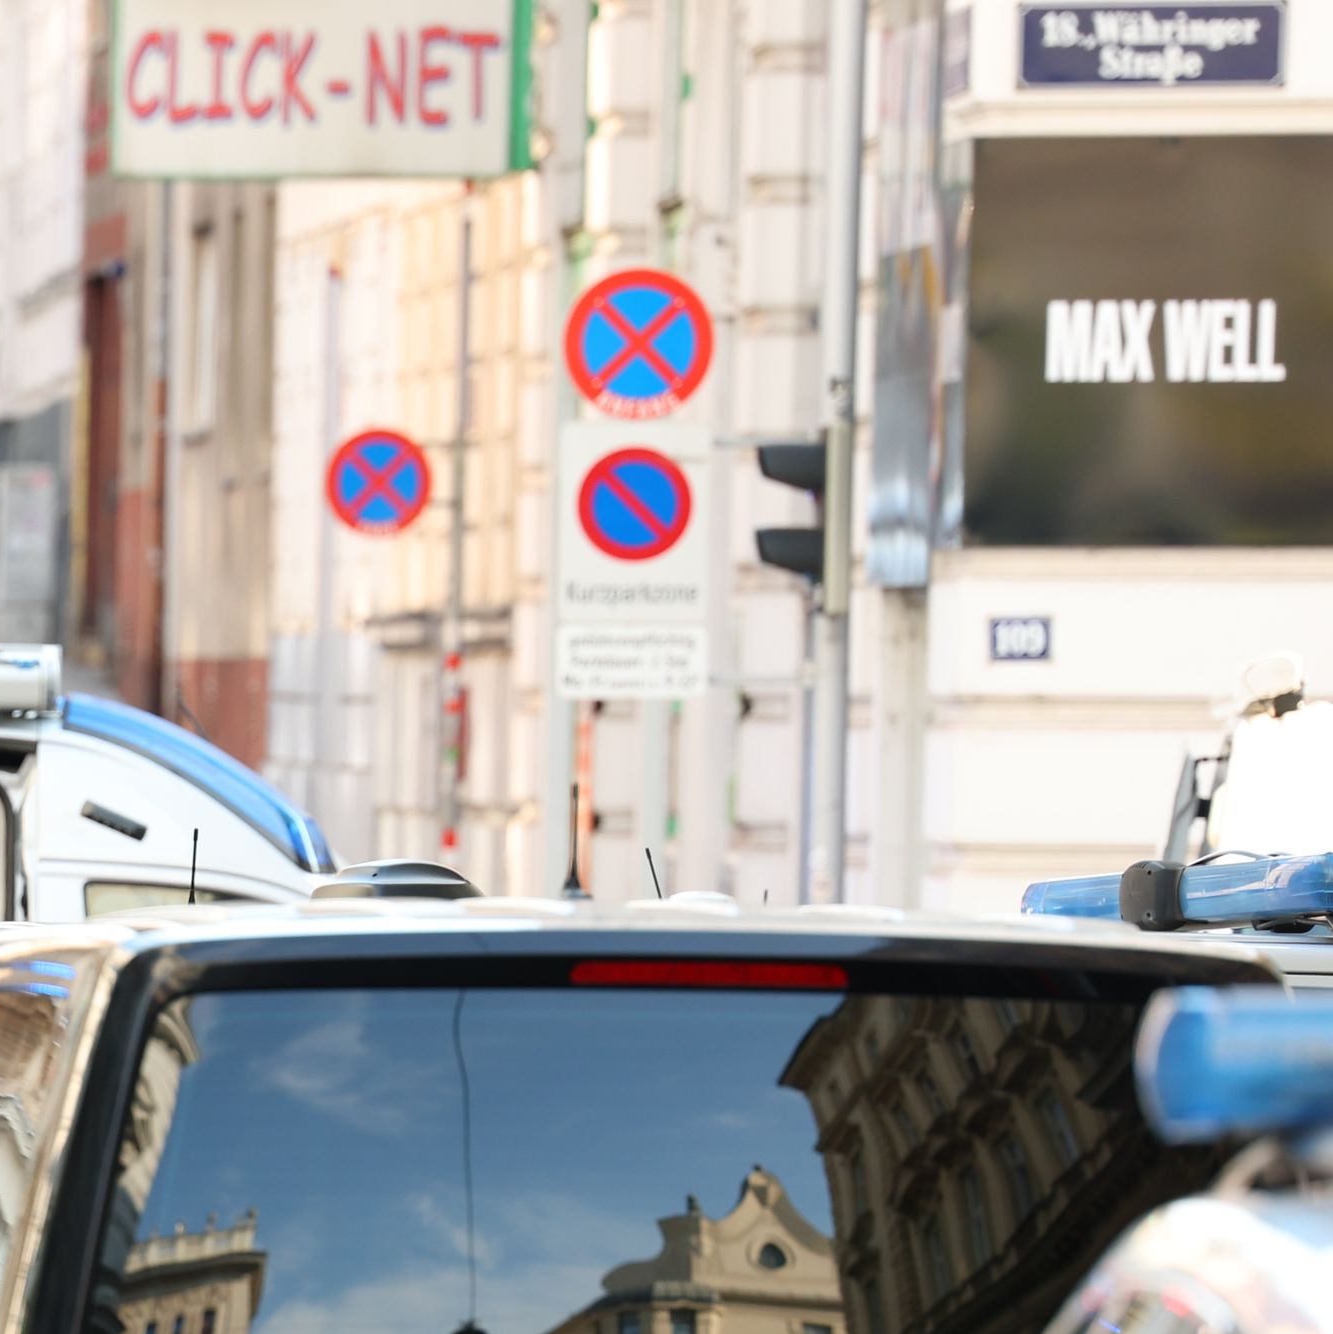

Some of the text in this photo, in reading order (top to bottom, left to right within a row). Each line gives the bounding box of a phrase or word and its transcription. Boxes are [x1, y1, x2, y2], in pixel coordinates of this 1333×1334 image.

[1098, 44, 1204, 85] Straße
[1044, 299, 1286, 383] MAX WELL
[996, 621, 1046, 656] 109
